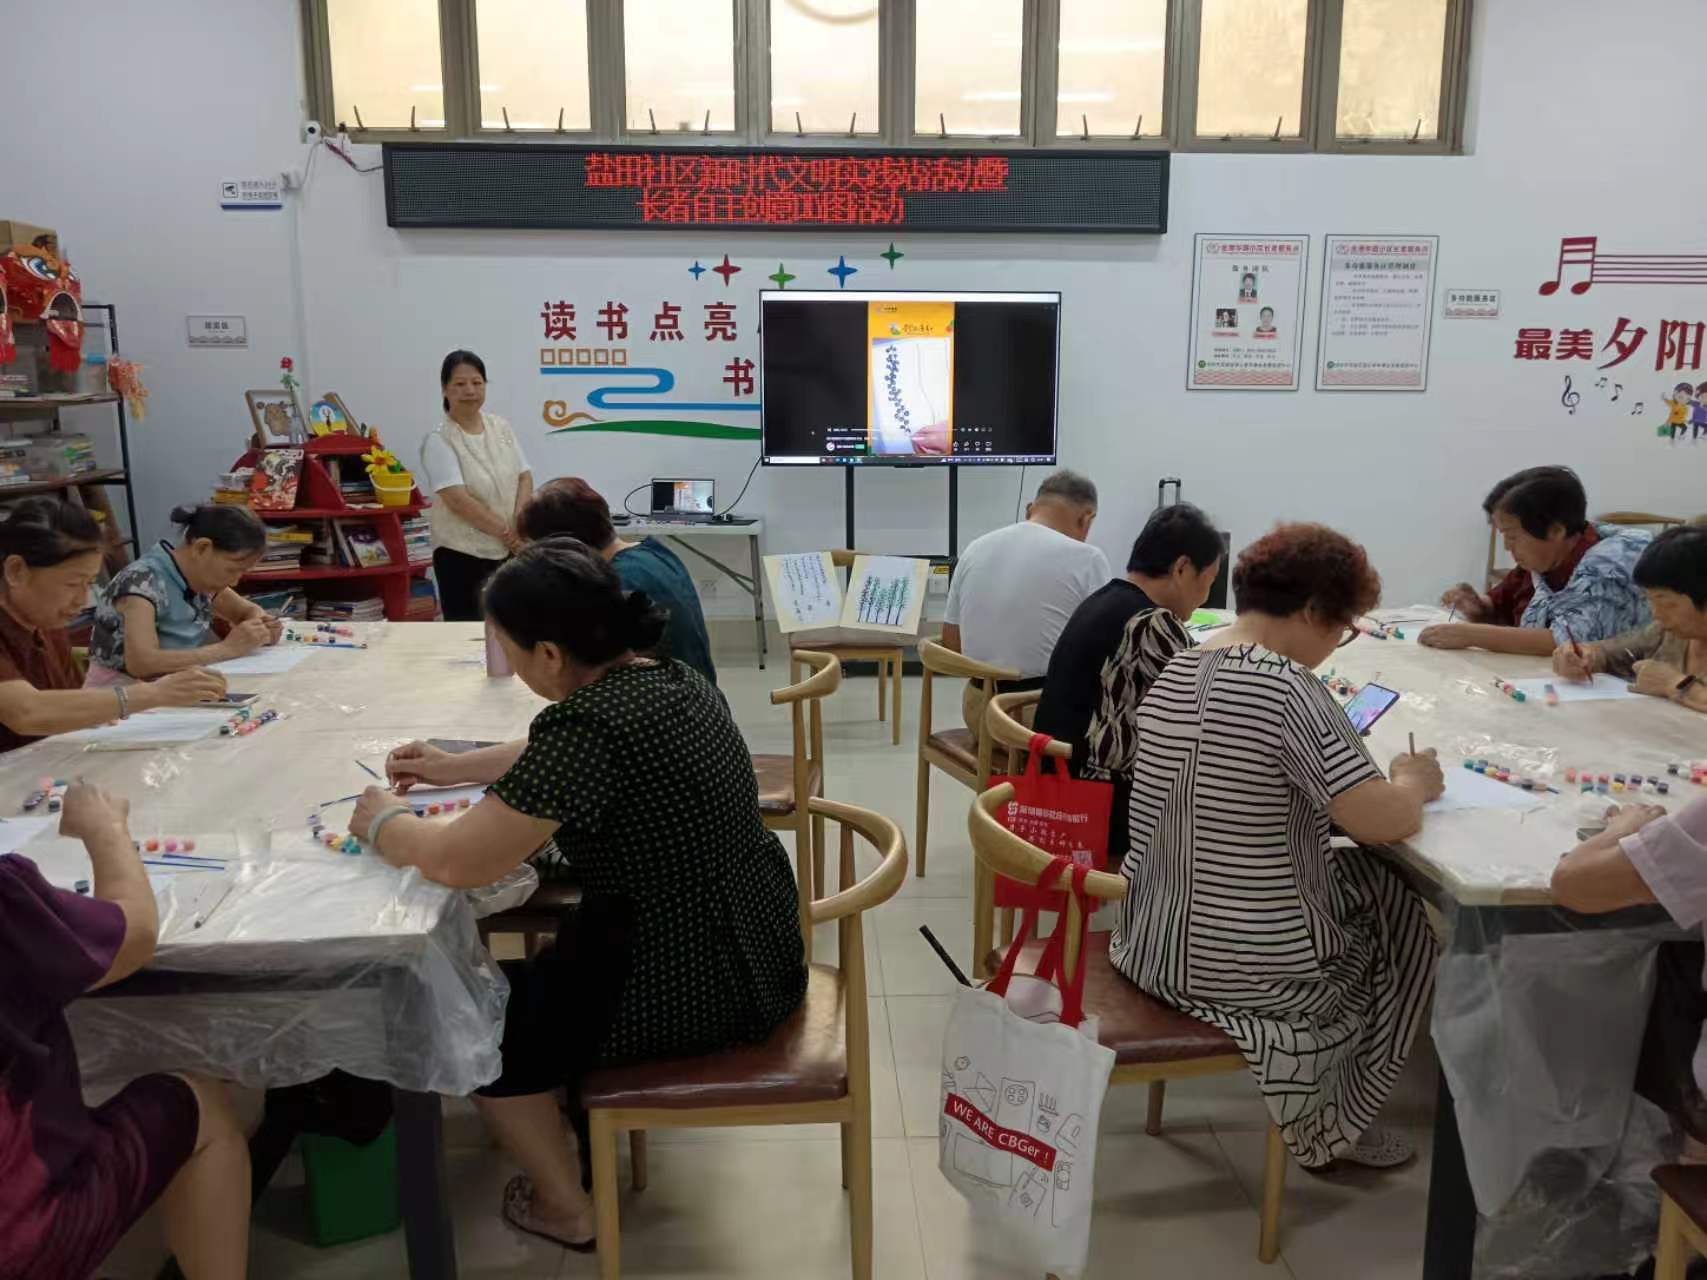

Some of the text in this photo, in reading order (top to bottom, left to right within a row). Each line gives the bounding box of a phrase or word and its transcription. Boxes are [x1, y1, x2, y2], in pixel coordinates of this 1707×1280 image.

[541, 301, 738, 341] 读书点亮
[1514, 317, 1706, 371] 最美夕阳
[723, 357, 756, 396] 书
[953, 1100, 973, 1122] WE
[973, 1116, 995, 1140] ARE
[998, 1133, 1040, 1158] CBGer
